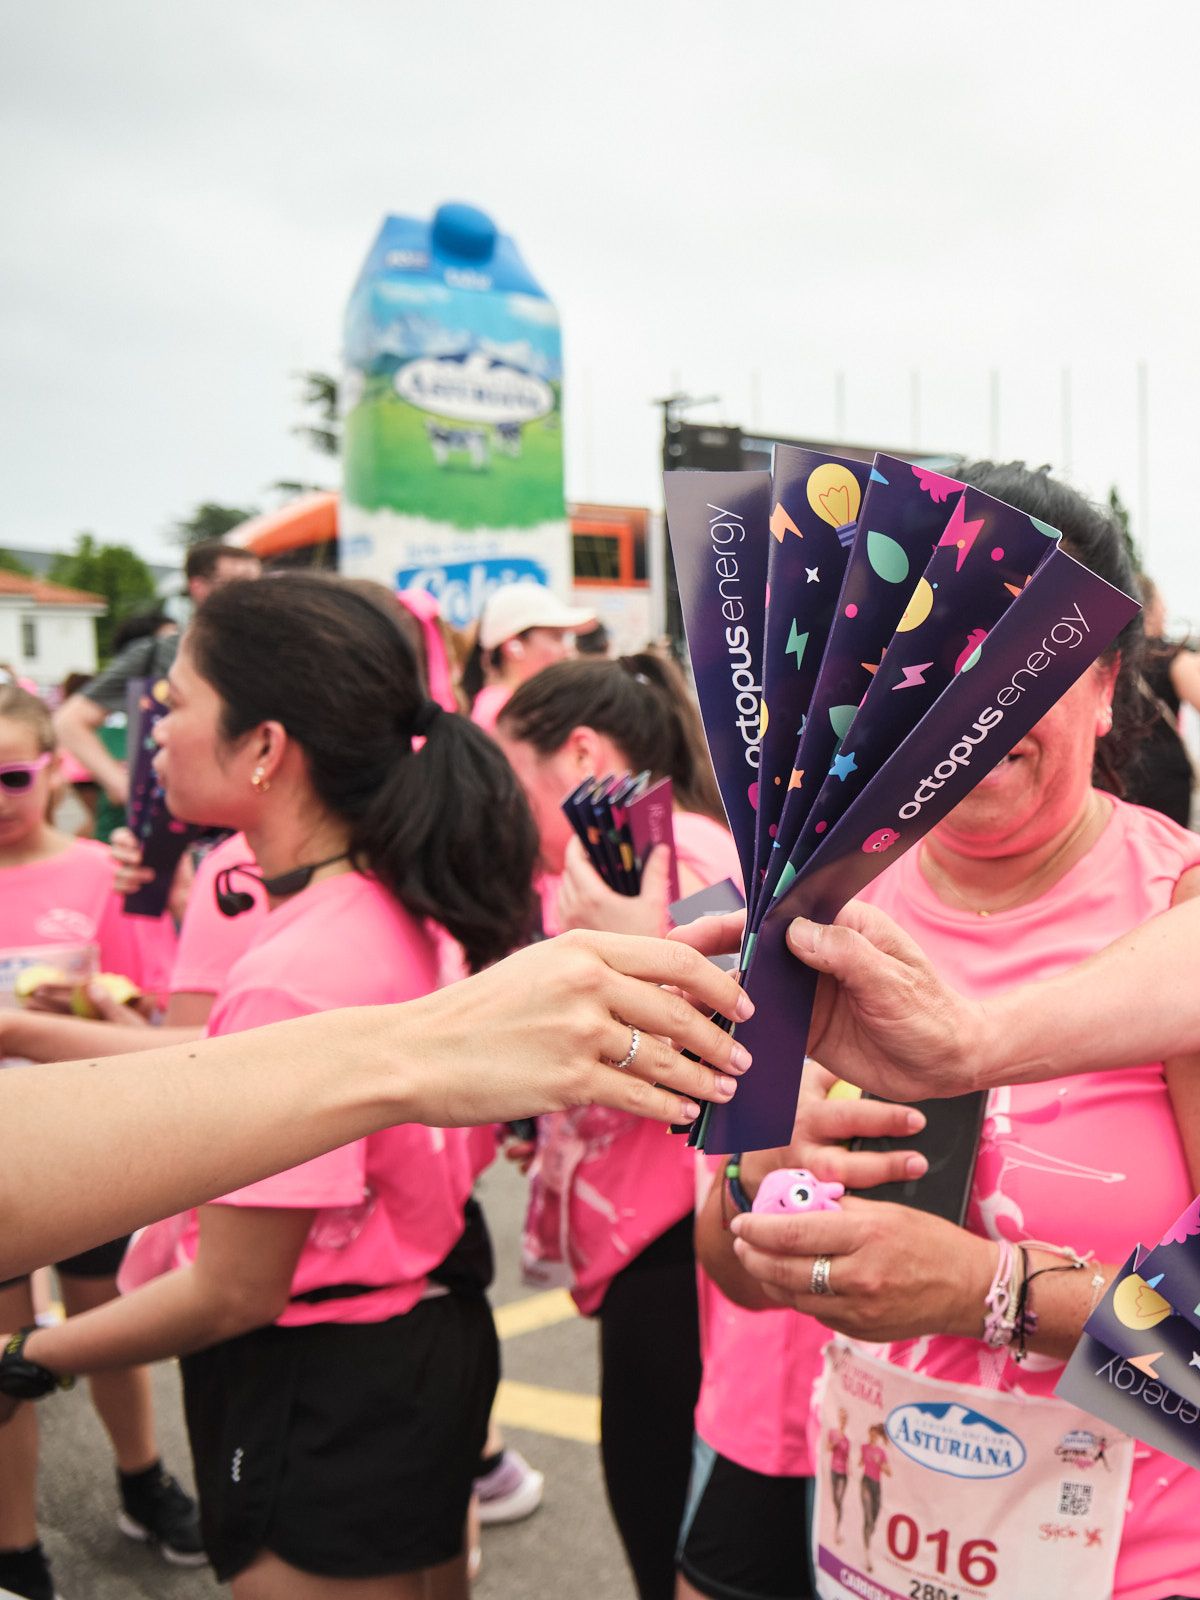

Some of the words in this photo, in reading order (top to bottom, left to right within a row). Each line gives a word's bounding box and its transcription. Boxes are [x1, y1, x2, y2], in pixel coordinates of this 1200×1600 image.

[898, 706, 1003, 820] octopus
[895, 1416, 1013, 1468] ASTURIANA
[887, 1513, 998, 1588] 016
